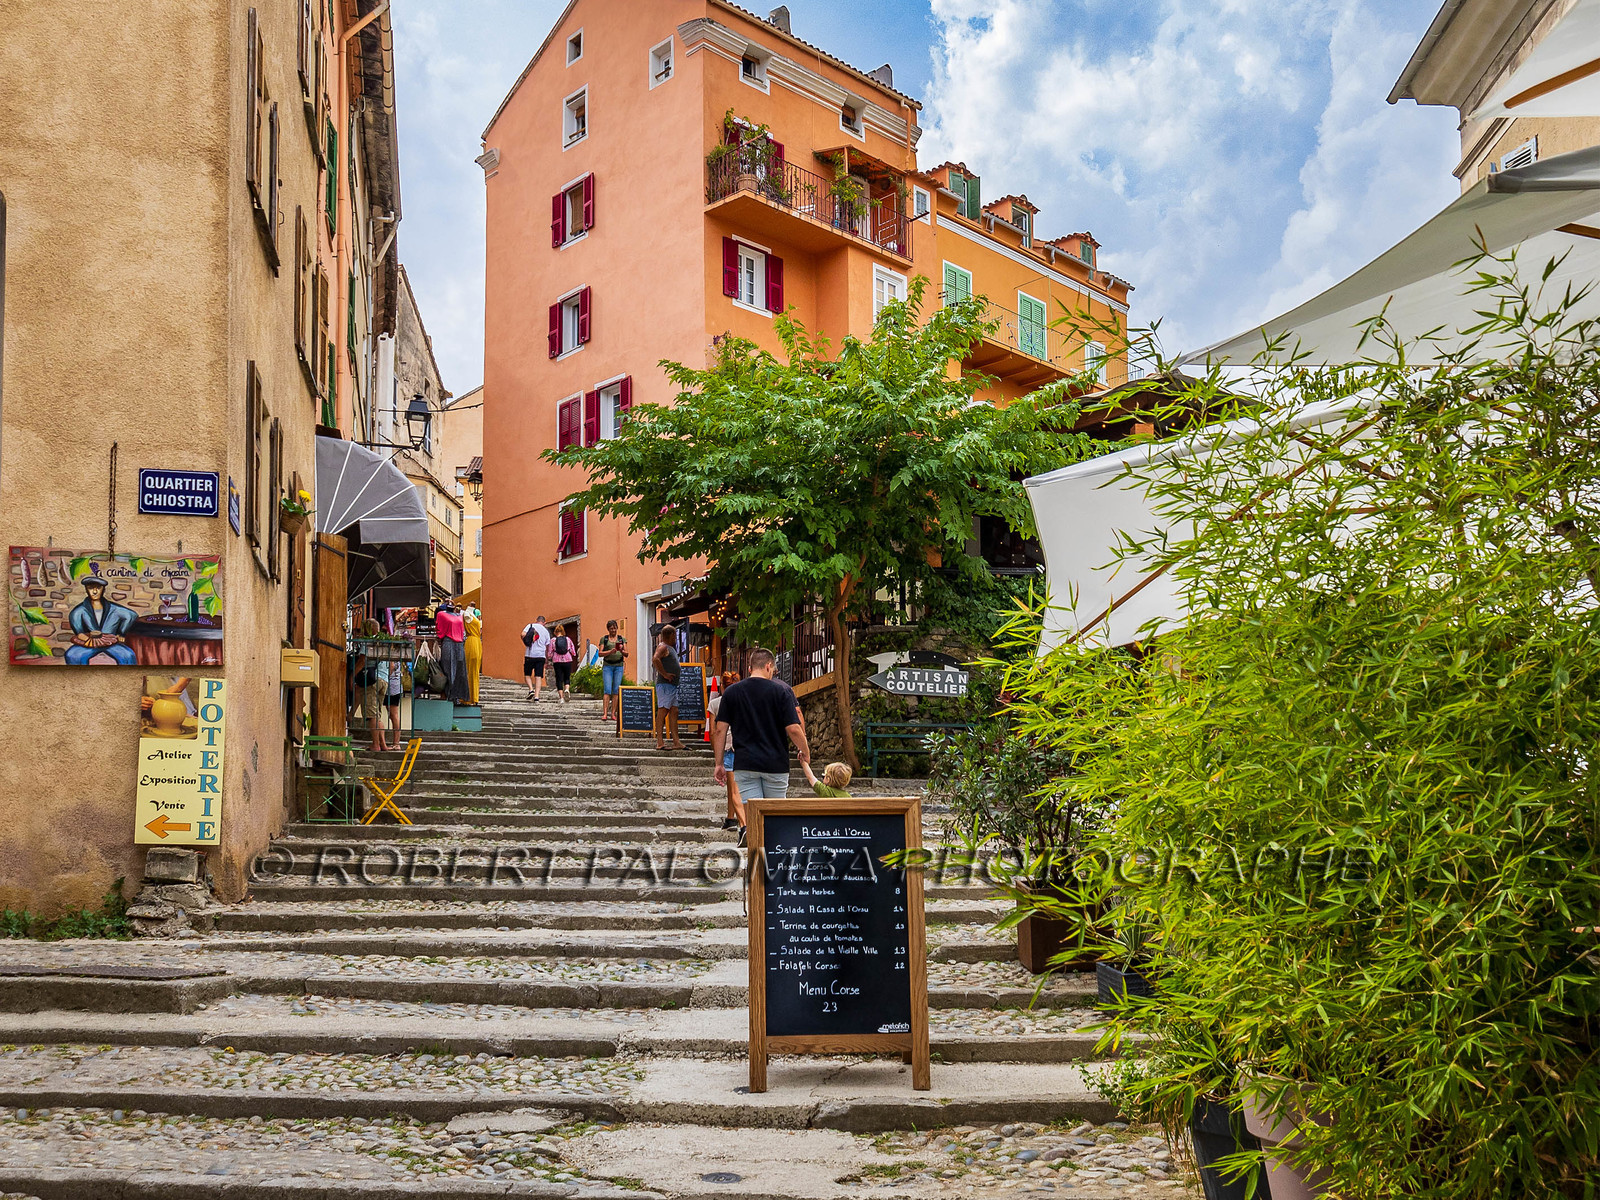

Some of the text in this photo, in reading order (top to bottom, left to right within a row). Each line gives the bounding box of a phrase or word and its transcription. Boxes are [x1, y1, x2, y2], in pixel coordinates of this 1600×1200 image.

[145, 476, 213, 492] QUARTIER
[144, 493, 213, 509] CHIOSTRA
[106, 566, 138, 578] cantina
[143, 566, 154, 577] di
[886, 670, 967, 684] ARTISAN
[886, 681, 967, 694] COUTELIER
[147, 750, 193, 761] Atelier
[196, 680, 223, 841] POTERIE
[140, 774, 197, 787] Exposition
[150, 800, 186, 812] Vente
[802, 826, 809, 837] A
[811, 827, 831, 837] Casa
[832, 827, 840, 836] di
[777, 887, 797, 896] Tarte
[811, 887, 835, 896] herbes
[895, 887, 901, 895] 8
[776, 903, 805, 915] Salade
[816, 905, 835, 914] Casa
[837, 905, 846, 913] di
[779, 920, 807, 930] Terrine
[809, 921, 820, 930] de
[789, 935, 800, 943] au
[800, 934, 820, 942] coulis
[823, 934, 832, 942] de
[780, 945, 812, 955] Salade
[815, 946, 825, 955] de
[862, 945, 879, 955] Ville
[894, 946, 906, 955] 13
[894, 961, 905, 970] 12
[799, 979, 860, 996] Menu Corse
[822, 1001, 838, 1013] 23
